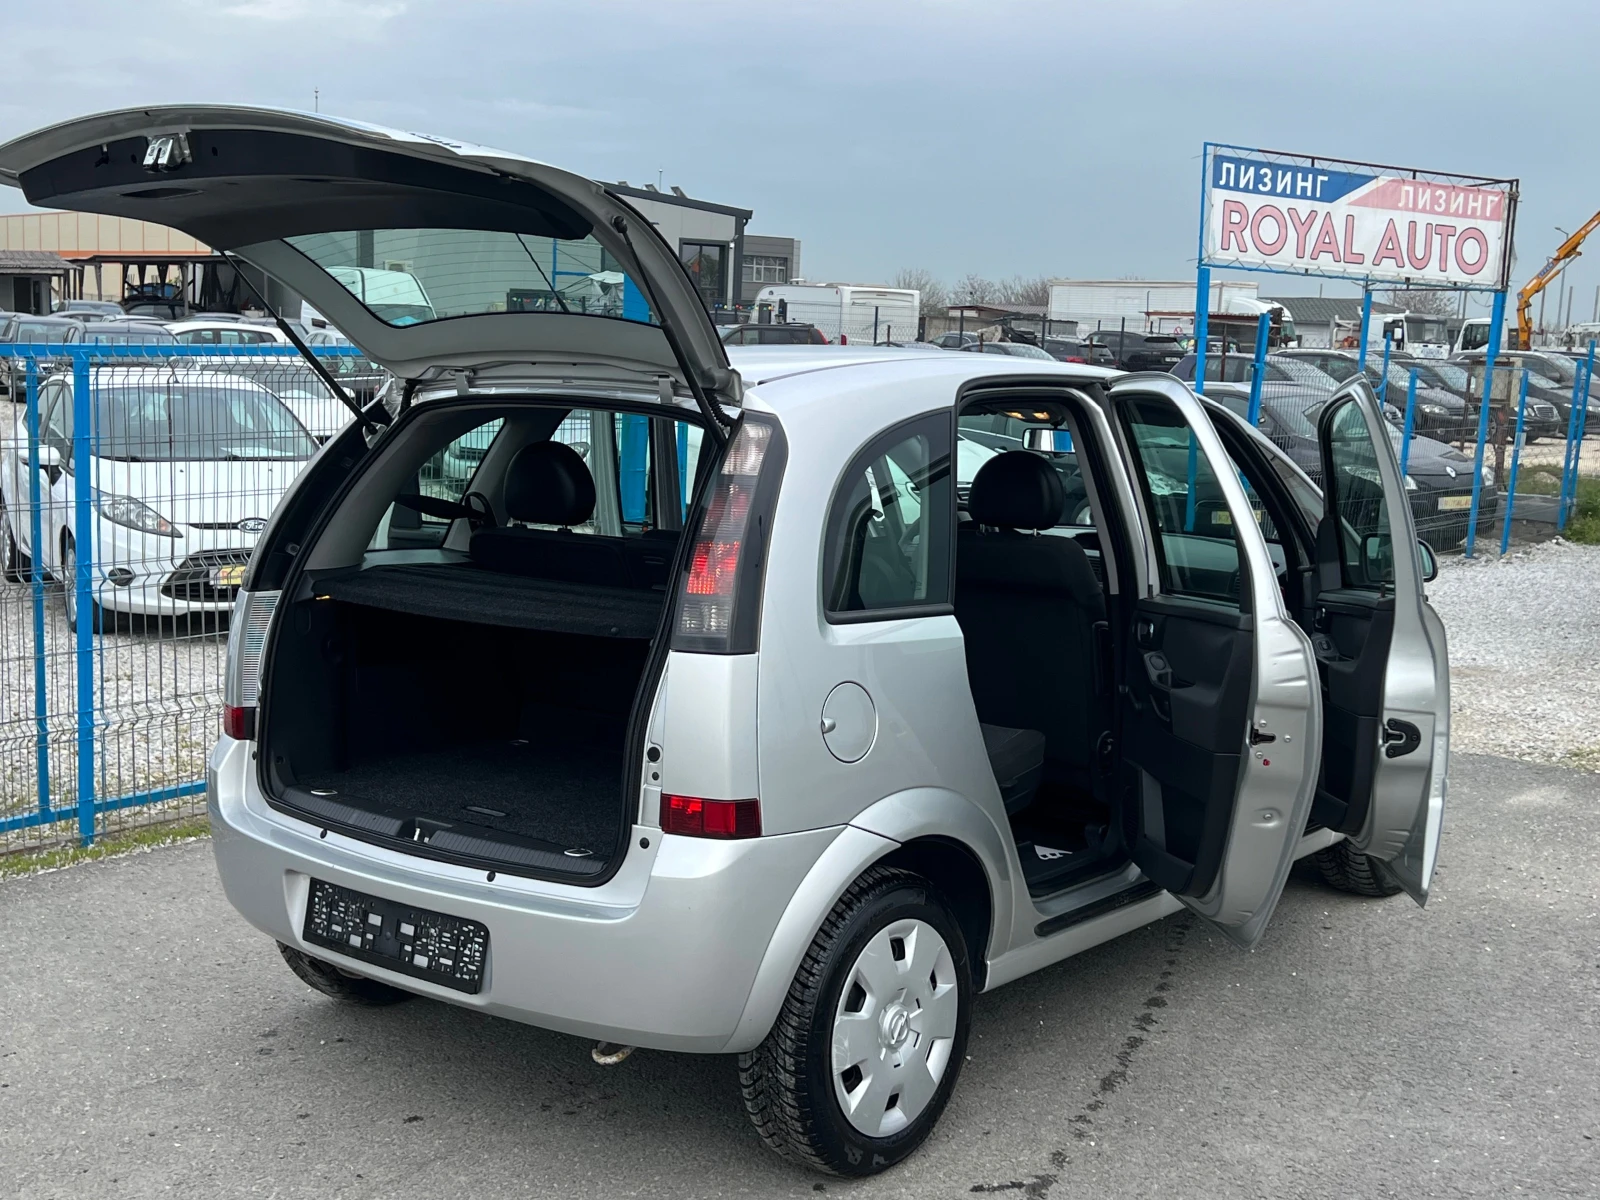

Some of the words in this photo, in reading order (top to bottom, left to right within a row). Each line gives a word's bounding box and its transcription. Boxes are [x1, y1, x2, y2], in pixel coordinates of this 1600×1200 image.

[1219, 163, 1328, 198] ЛИЗИНГ
[1398, 185, 1498, 217] ЛИЗИНГ
[1220, 200, 1365, 264] ROYAL
[1372, 219, 1488, 275] AUTO
